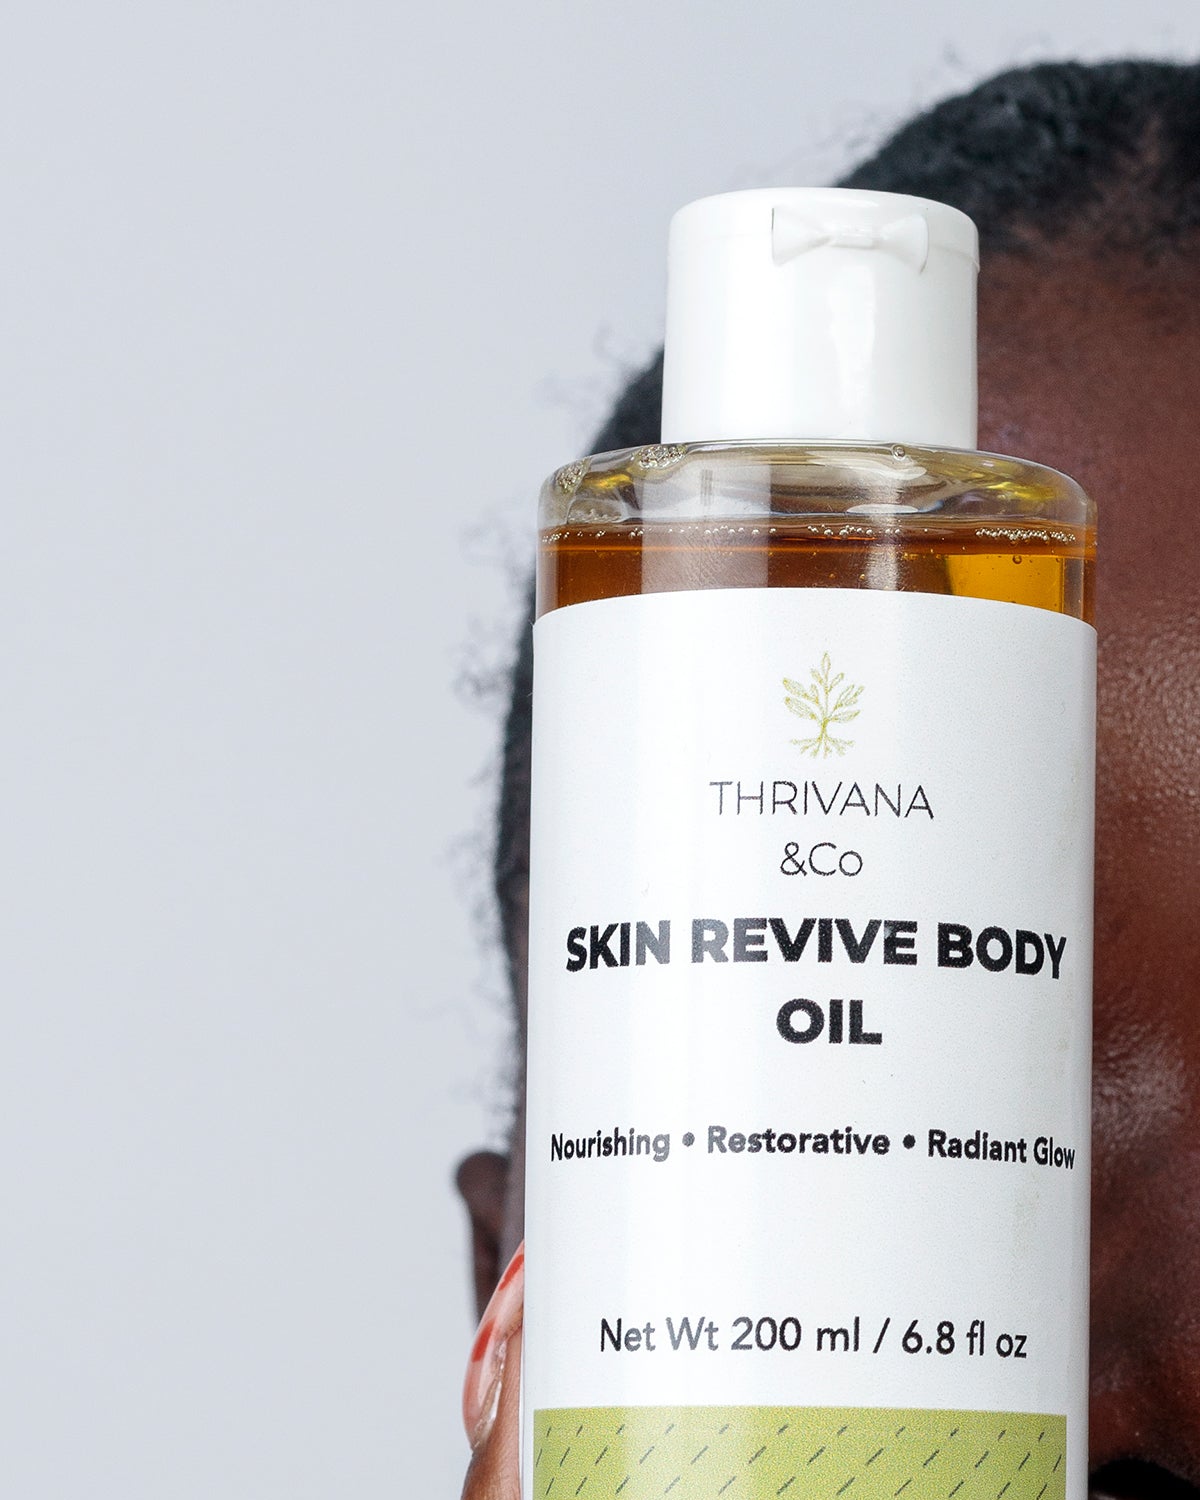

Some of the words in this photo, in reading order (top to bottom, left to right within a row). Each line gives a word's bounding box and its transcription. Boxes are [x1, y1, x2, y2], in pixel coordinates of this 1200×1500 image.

[709, 780, 936, 820] THRIVANA
[778, 841, 865, 878] &Co
[565, 918, 672, 974] SKIN
[690, 917, 919, 966] REVIVE
[936, 921, 1068, 981] BODY
[775, 997, 884, 1046] OIL
[549, 1125, 671, 1163] Nourishing
[706, 1124, 892, 1156] Restorative
[926, 1127, 1028, 1165] Radiant
[1032, 1134, 1077, 1171] Glow
[599, 1316, 657, 1353] Net
[665, 1315, 720, 1352] Wt
[730, 1315, 803, 1353] 200
[815, 1315, 861, 1353] ml
[900, 1318, 957, 1357] 6.8
[964, 1318, 986, 1358] fl
[994, 1331, 1029, 1360] oz
